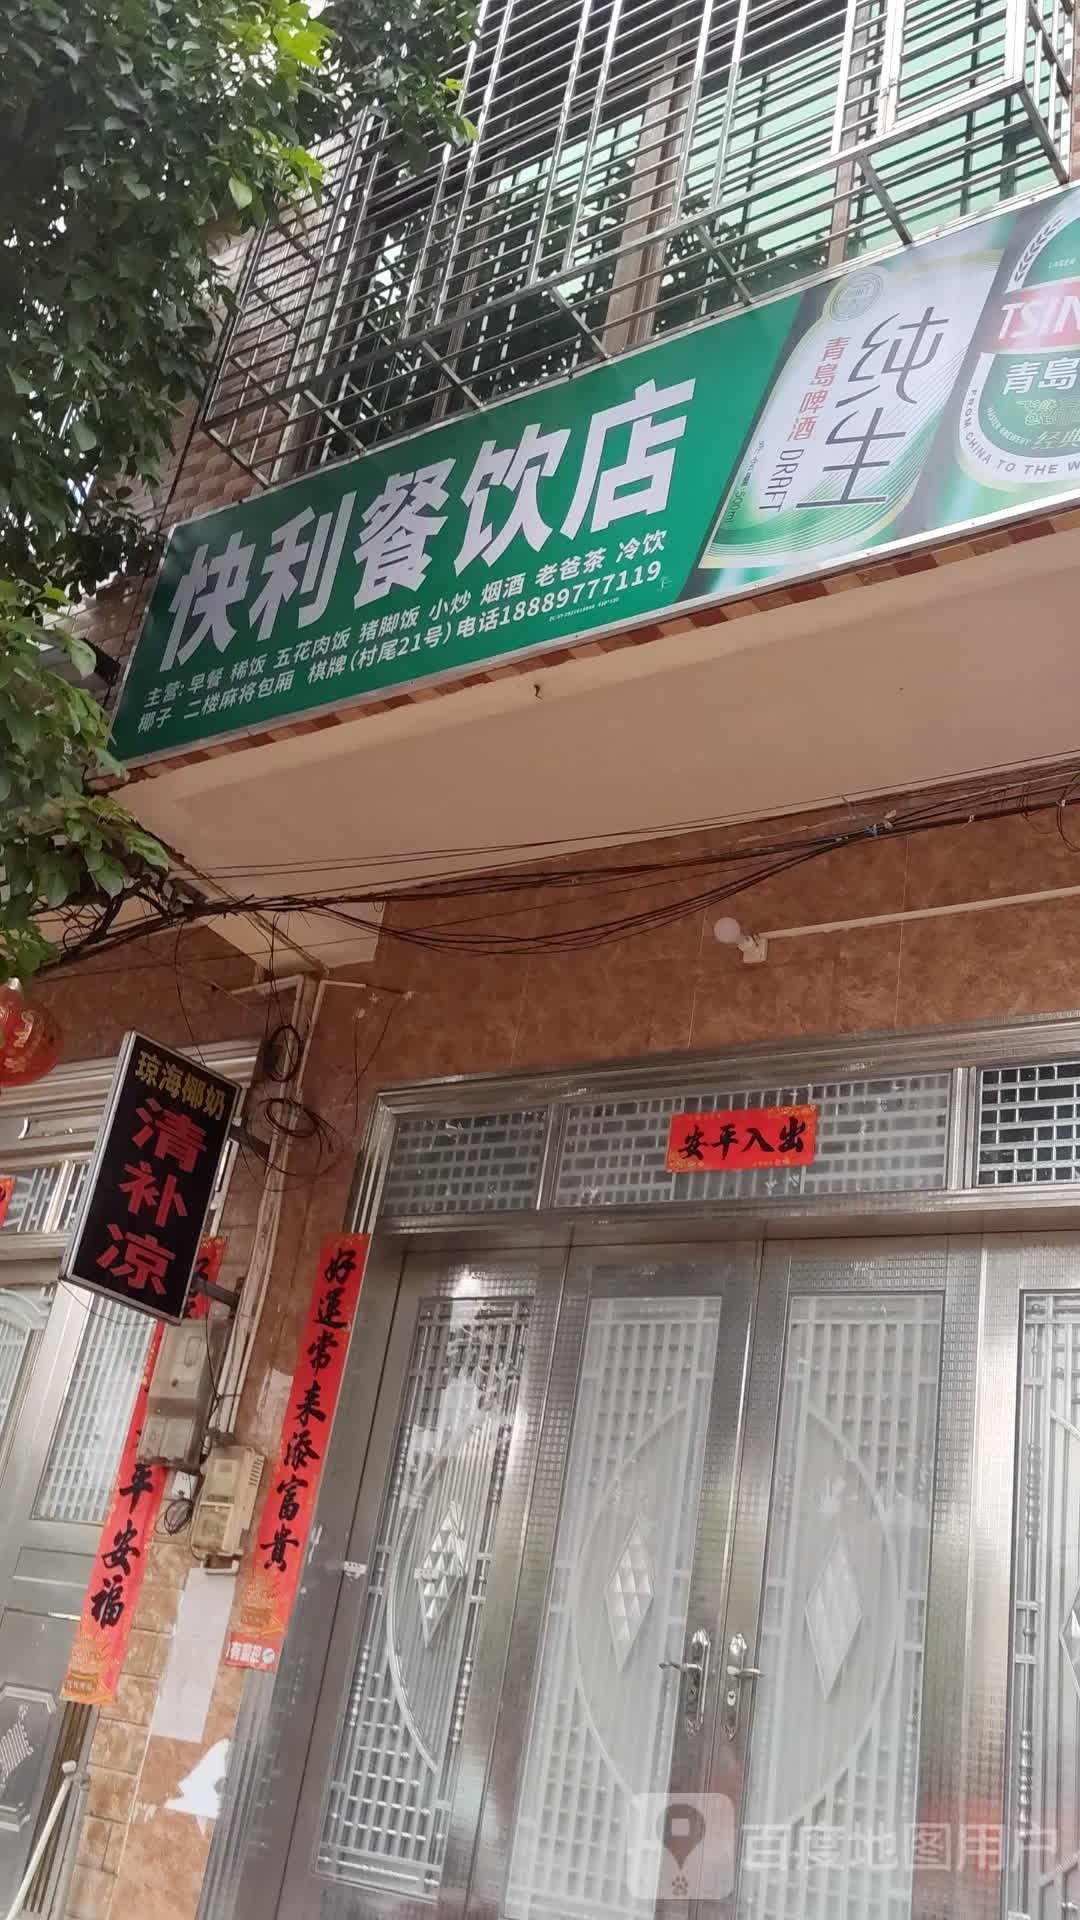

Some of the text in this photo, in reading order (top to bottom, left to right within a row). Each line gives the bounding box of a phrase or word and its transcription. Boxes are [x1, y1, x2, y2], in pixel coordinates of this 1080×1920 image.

[796, 306, 949, 508] 纯生
[966, 431, 992, 465] CHINA
[997, 459, 1016, 473] TO
[1023, 463, 1059, 476] THE
[160, 378, 696, 672] 快利餐饮店
[758, 448, 804, 512] DRAFT
[230, 653, 268, 684] 稀饭
[273, 628, 351, 669] 五花肉饭
[358, 606, 420, 644] 猪脚饭
[428, 591, 472, 621] 小炒
[480, 572, 527, 606] 烟酒
[534, 547, 607, 587] 老爸茶
[615, 529, 667, 563] 冷饮
[137, 707, 172, 735] 椰子
[183, 669, 296, 720] 二楼麻将包厢
[135, 1050, 226, 1121] 琼海椰奶
[96, 1098, 207, 1296] 清补凉
